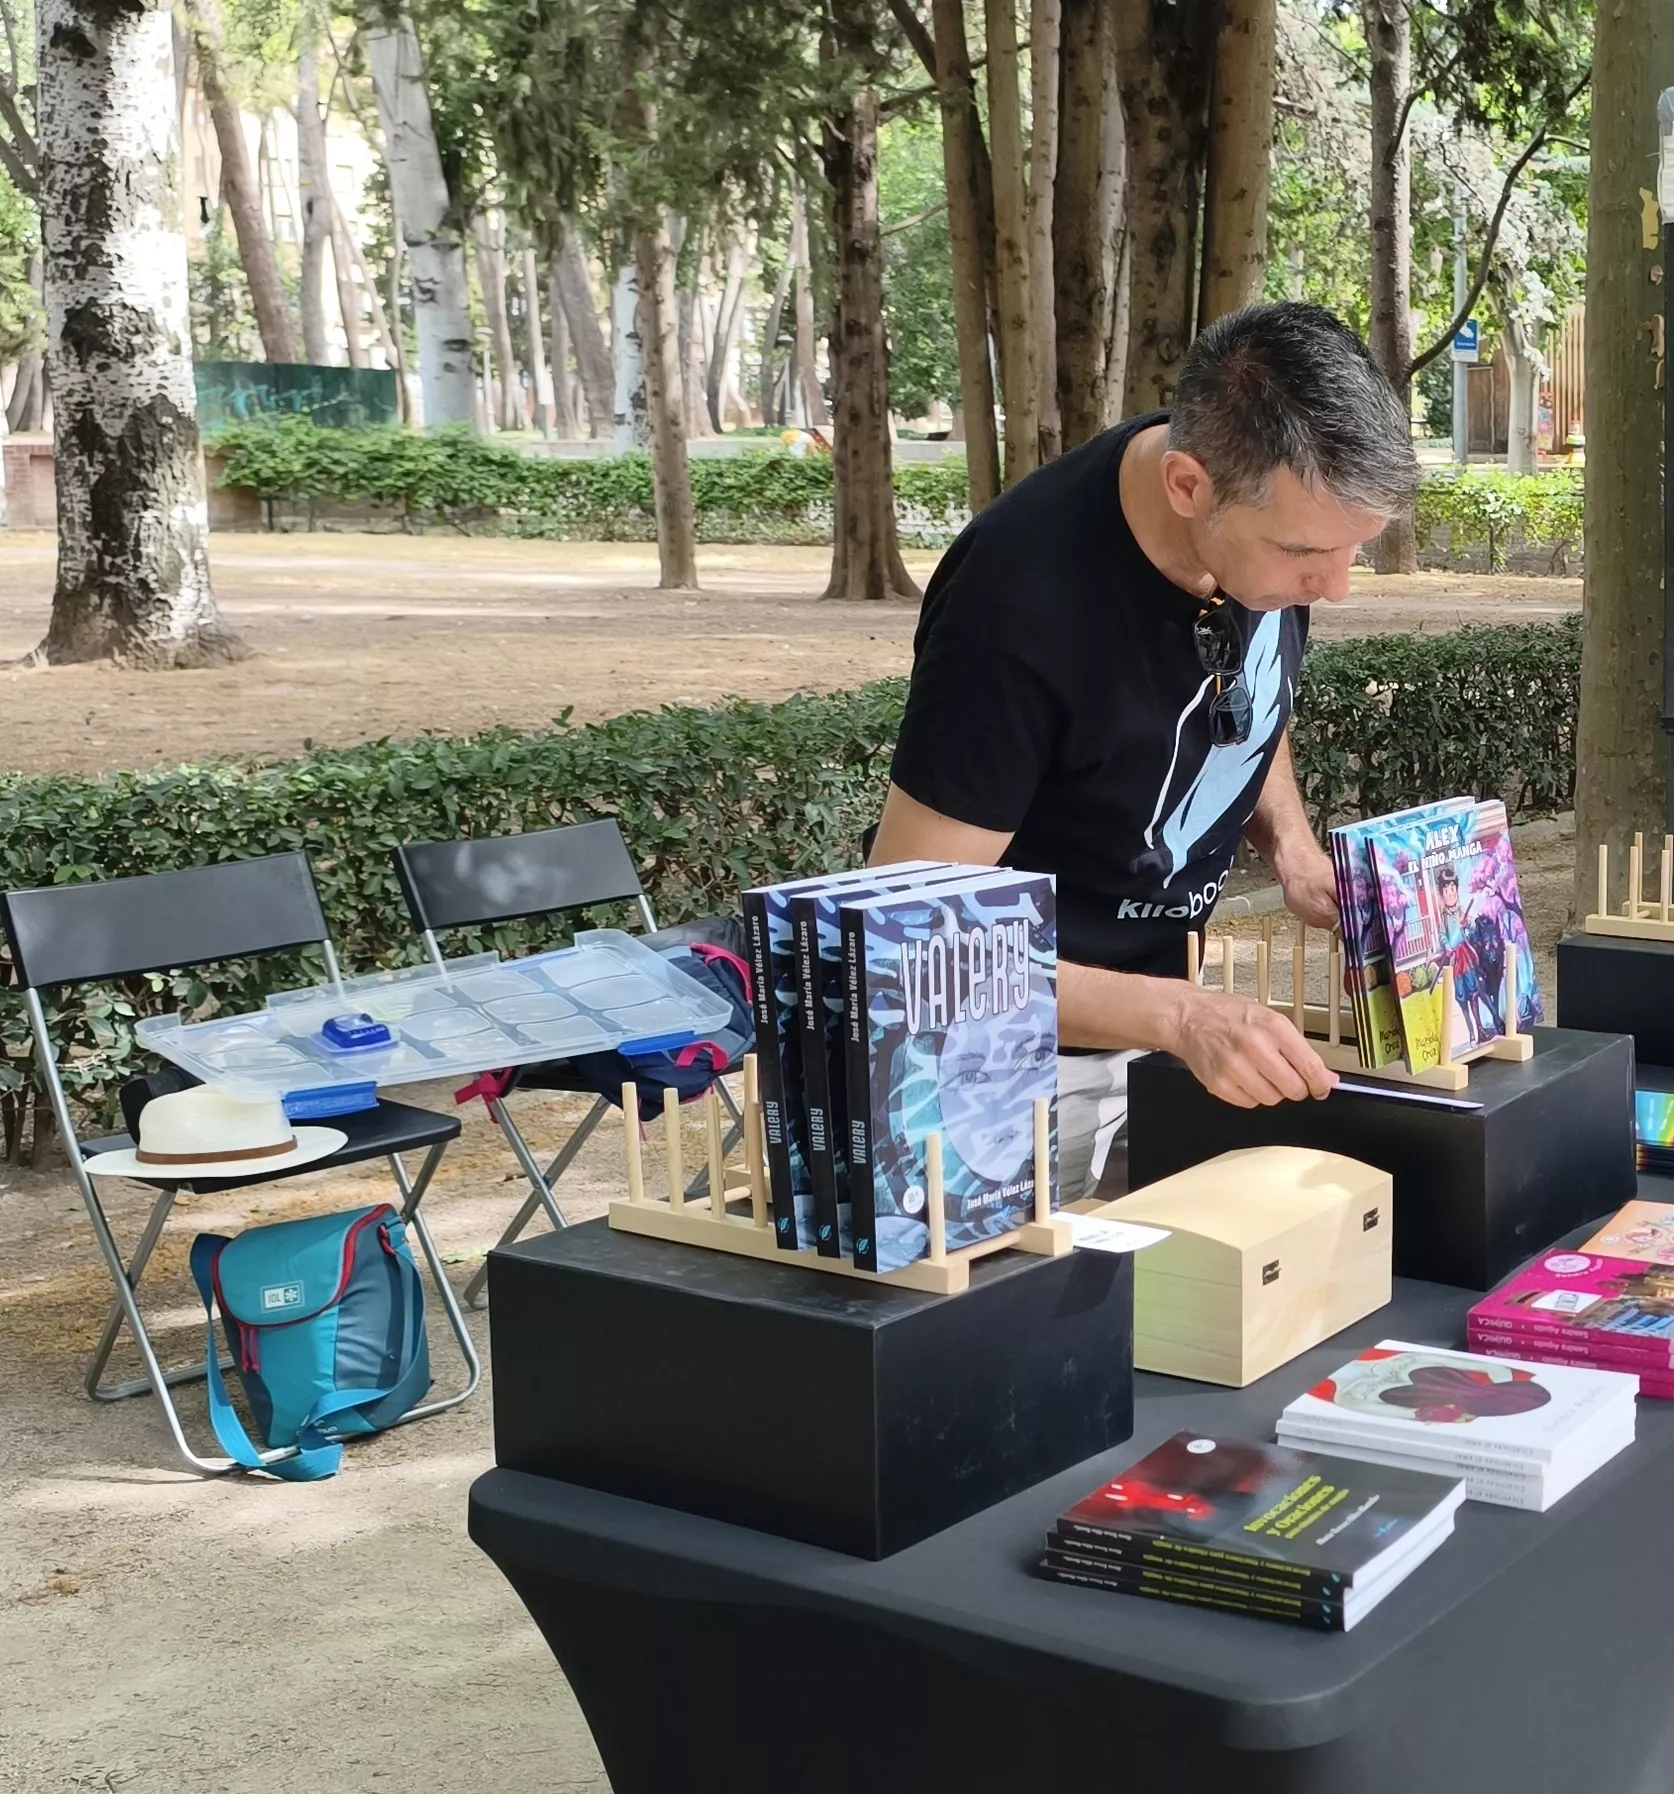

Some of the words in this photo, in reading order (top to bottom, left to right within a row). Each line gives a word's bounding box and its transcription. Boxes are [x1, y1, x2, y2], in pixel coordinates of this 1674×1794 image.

[1425, 823, 1460, 852] ALEX
[1421, 851, 1446, 869] NIÑO
[1448, 840, 1483, 861] MANGA
[752, 915, 761, 946] Lázaro
[800, 921, 809, 952] Lázaro
[755, 948, 763, 973] Vélez
[848, 932, 857, 963] Lázaro
[802, 954, 811, 980] Vélez
[849, 965, 857, 991] Vélez
[757, 975, 766, 1002] María
[804, 981, 813, 1008] María
[759, 1004, 768, 1024] José
[850, 993, 859, 1019] María
[805, 1010, 815, 1030] José
[851, 1021, 860, 1042] José
[967, 1196, 982, 1210] José
[1002, 1184, 1019, 1199] Vélez
